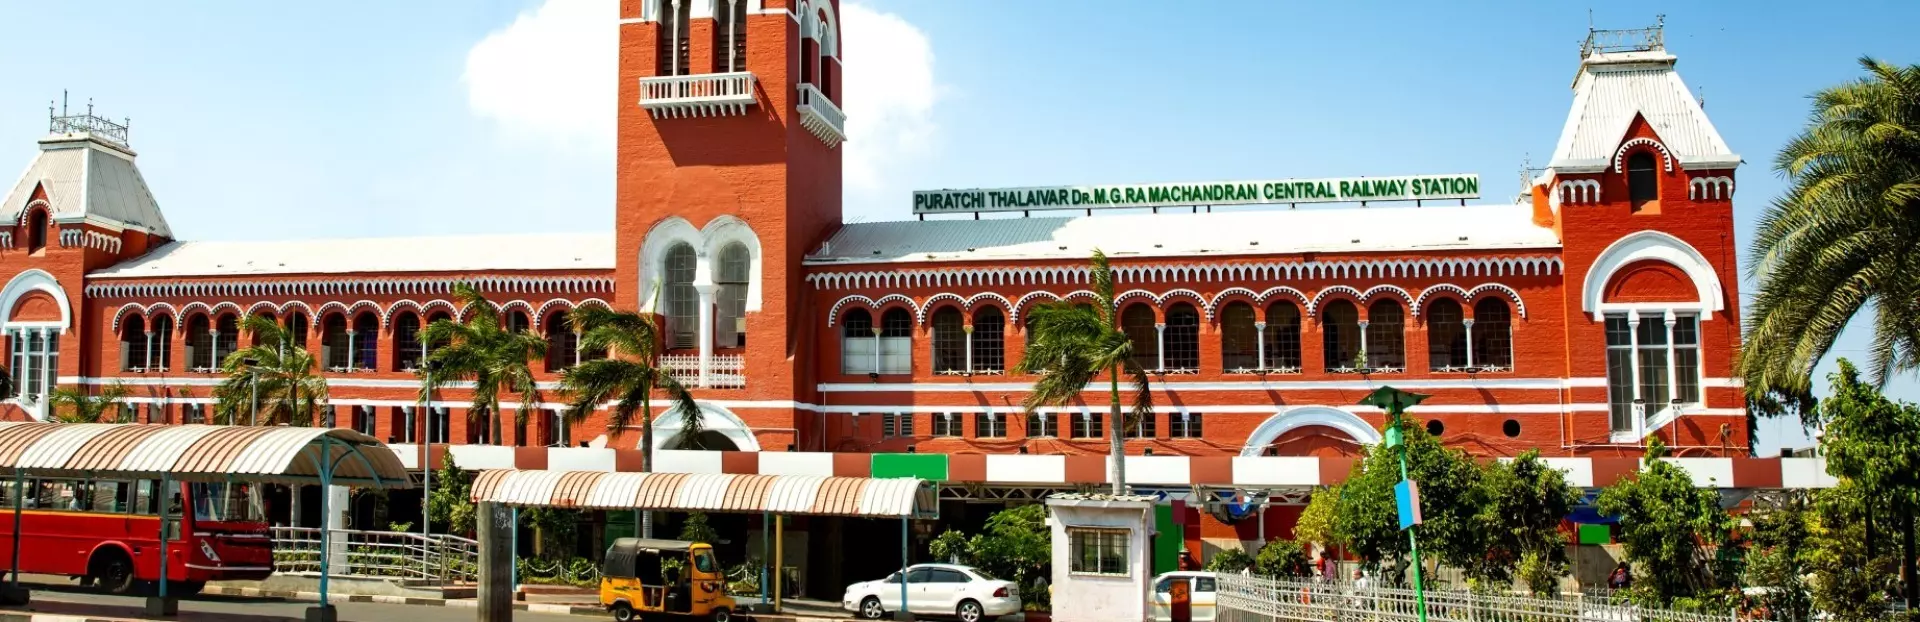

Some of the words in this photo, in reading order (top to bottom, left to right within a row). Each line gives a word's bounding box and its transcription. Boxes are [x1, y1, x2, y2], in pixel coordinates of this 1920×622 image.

[915, 192, 985, 210] PURATCHI
[988, 189, 1069, 208] THALAIVAR
[1263, 181, 1336, 200] CENTRAL
[1339, 179, 1407, 198] RAILWAY
[1411, 177, 1477, 195] STATION
